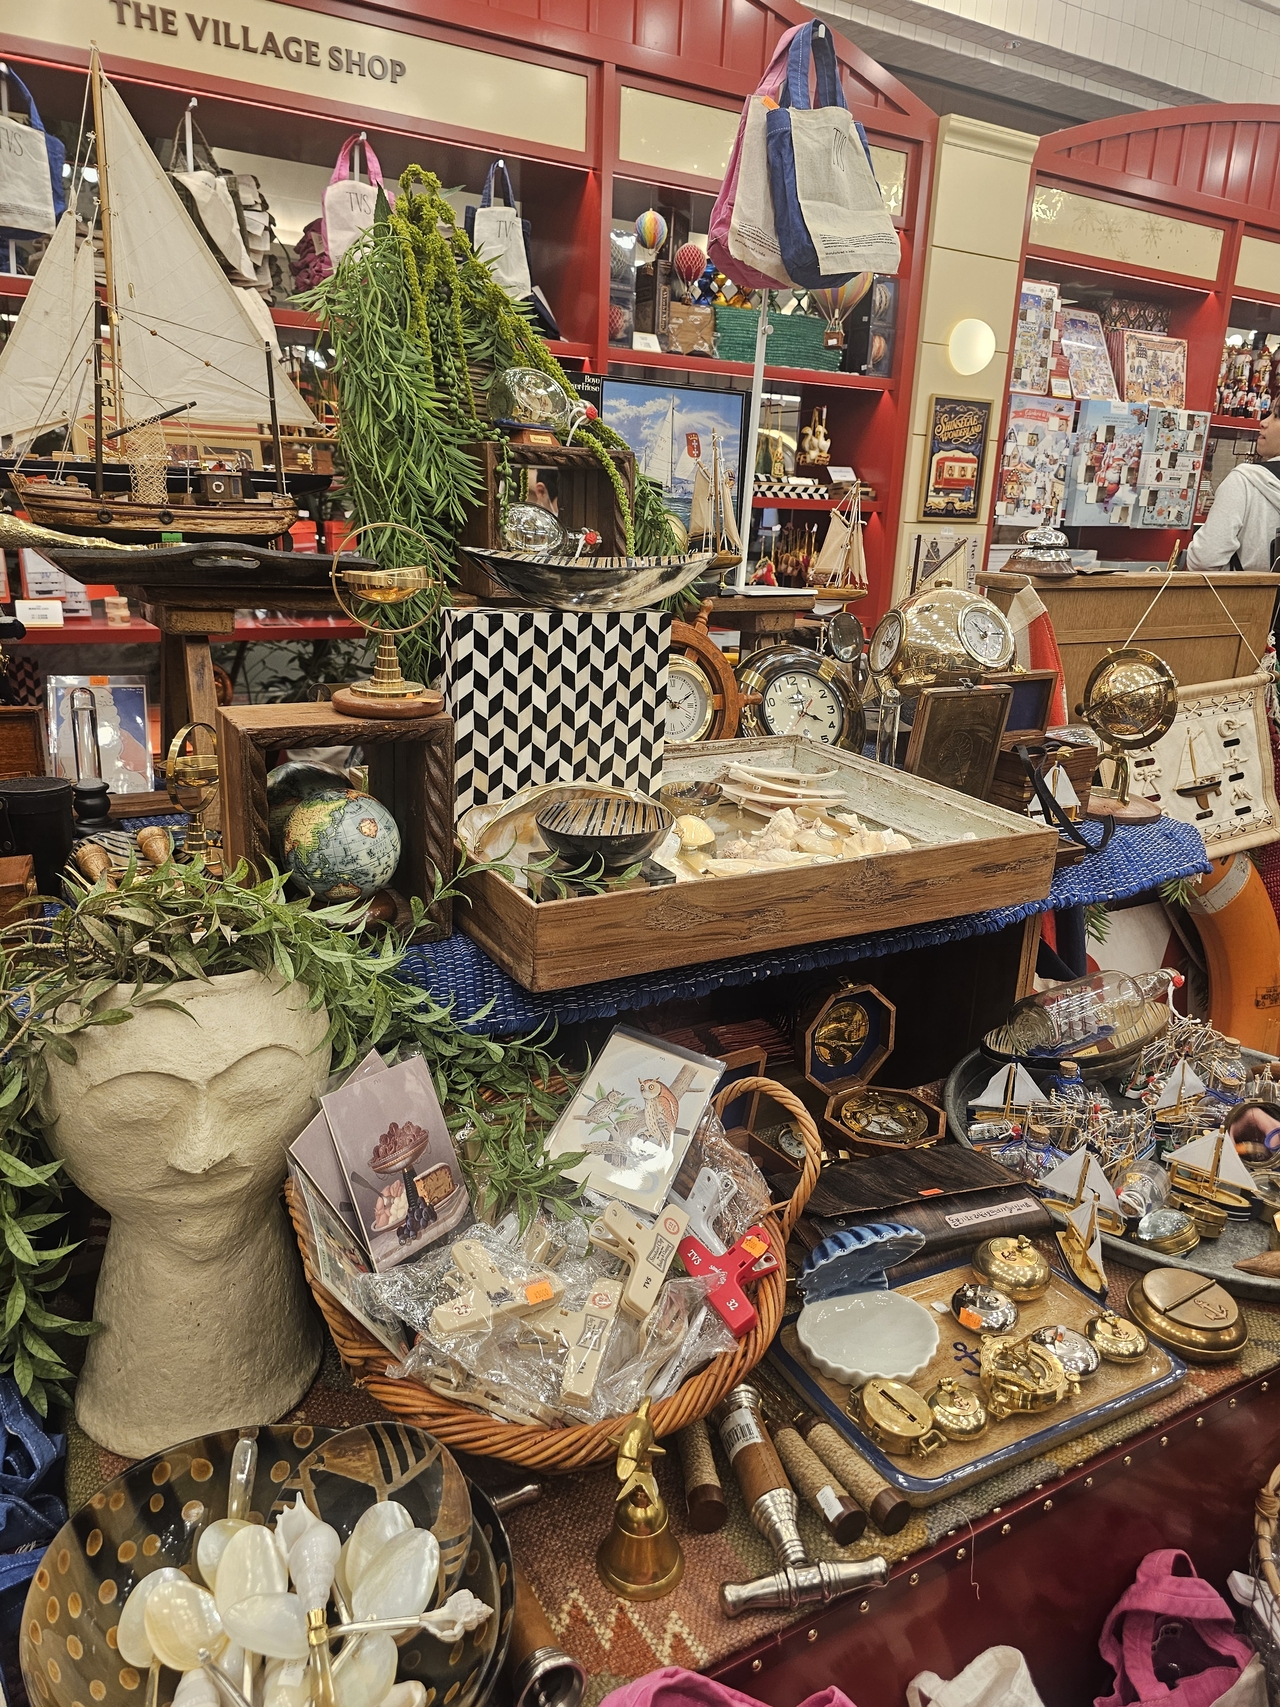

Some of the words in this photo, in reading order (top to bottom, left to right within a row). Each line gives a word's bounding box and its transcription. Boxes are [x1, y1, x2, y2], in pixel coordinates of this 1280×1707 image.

[110, 0, 178, 36] THE
[185, 13, 321, 66] VILLAGE
[328, 46, 407, 84] SHOP
[832, 127, 847, 172] TVS
[345, 191, 372, 215] TVS
[935, 412, 979, 436] SHINSEGAE
[940, 425, 982, 443] WONDERLAND
[786, 676, 798, 686] 12
[807, 679, 812, 688] 1
[773, 684, 783, 693] 11
[818, 689, 828, 699] 2
[766, 698, 776, 708] 10
[826, 705, 836, 715] 3
[828, 721, 836, 730] 4
[820, 735, 830, 744] 5
[687, 1249, 702, 1266] TVS
[642, 1276, 652, 1289] TVS
[726, 1298, 739, 1311] 32
